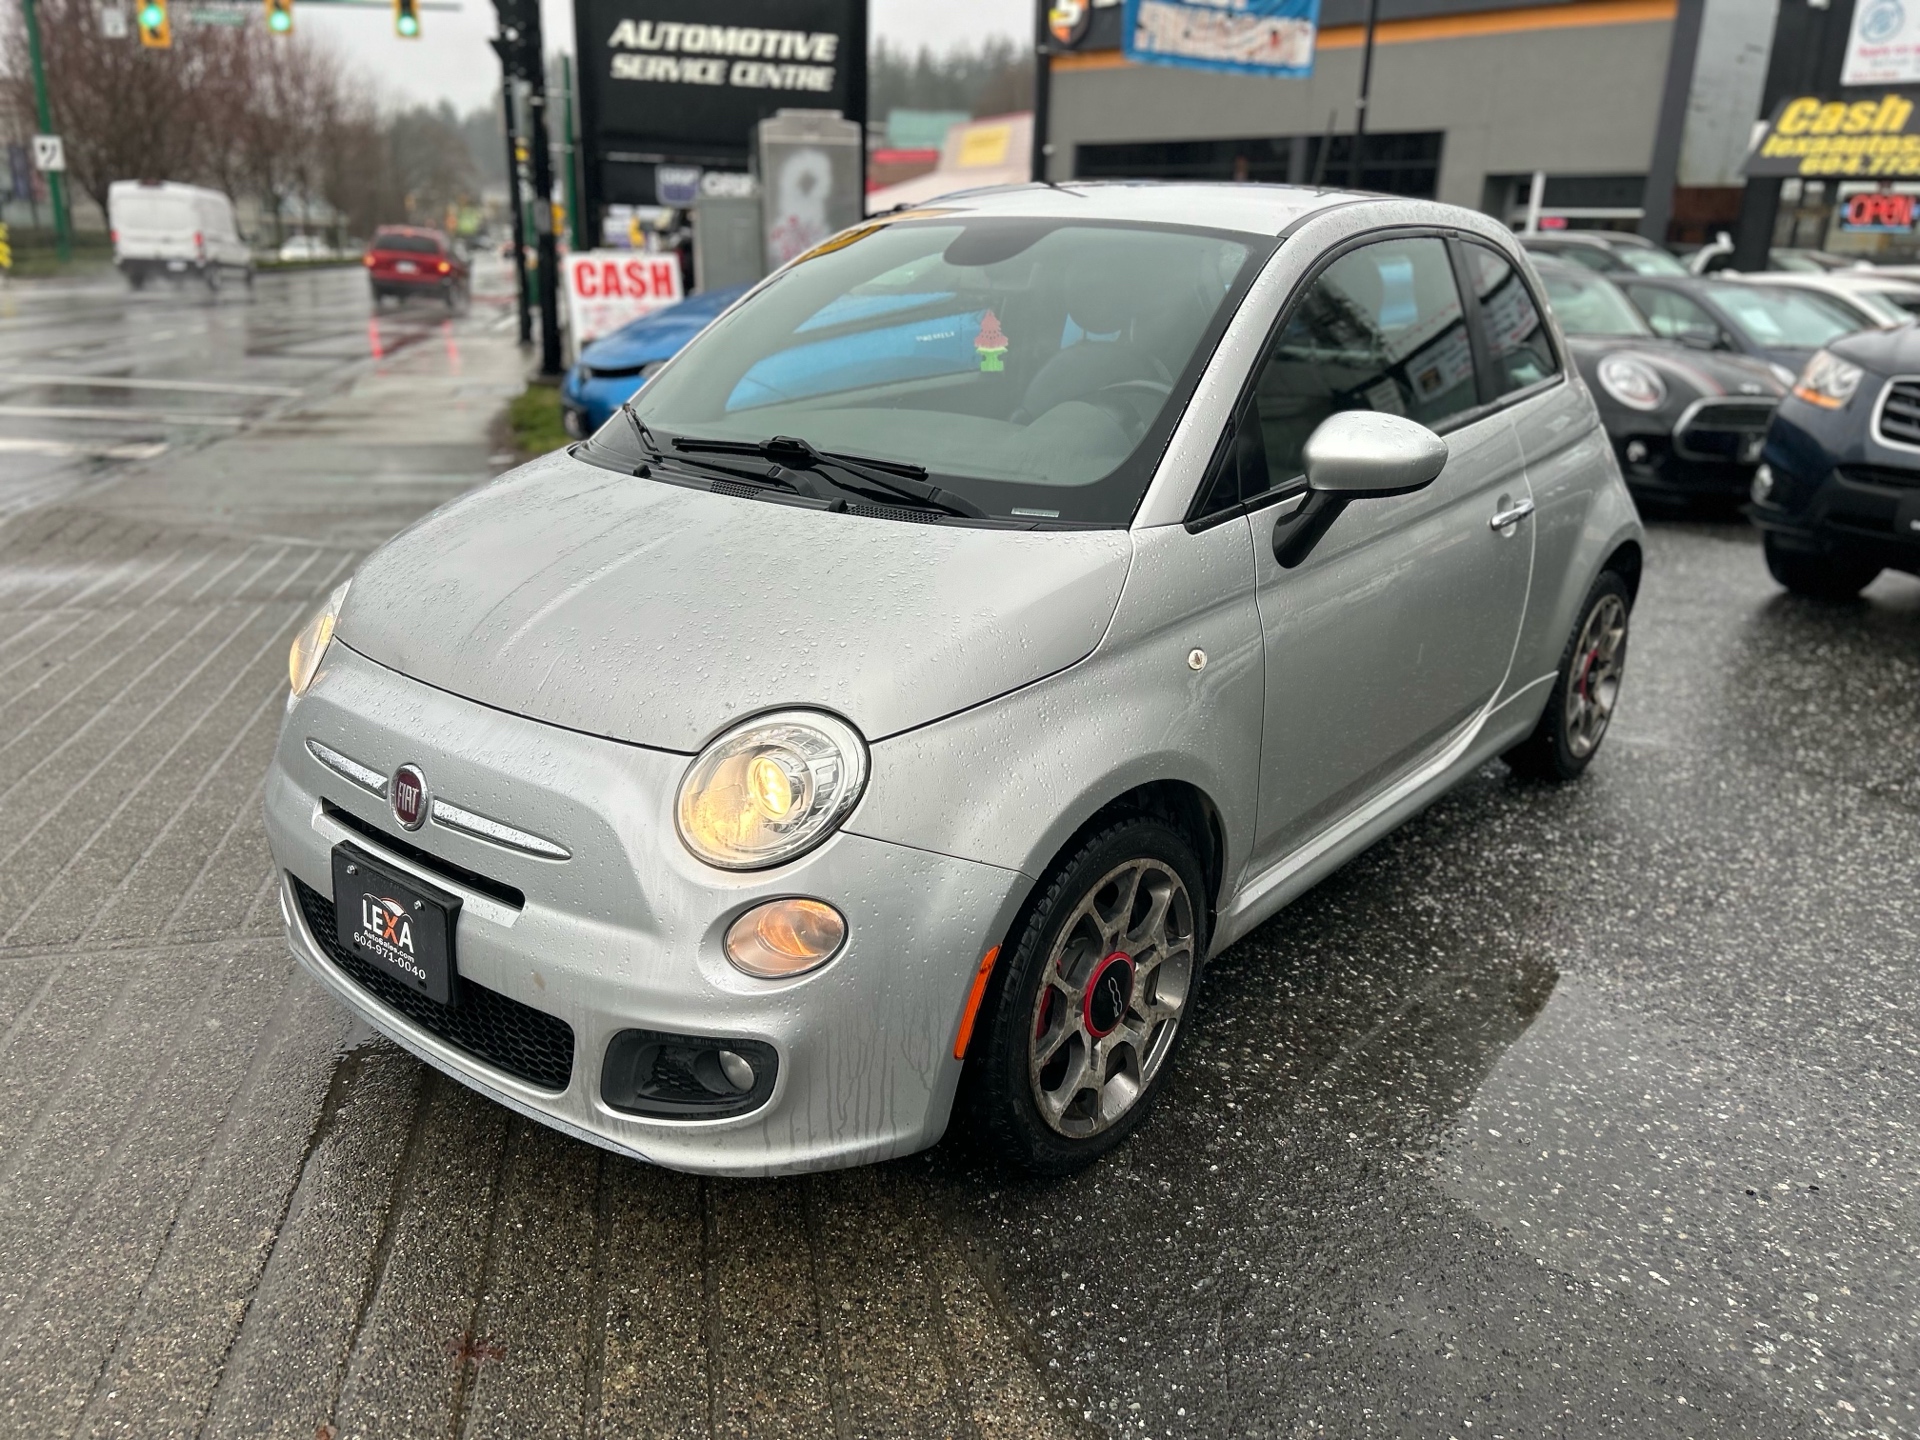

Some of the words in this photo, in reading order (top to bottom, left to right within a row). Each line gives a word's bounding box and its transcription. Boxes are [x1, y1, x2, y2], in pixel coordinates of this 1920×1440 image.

[608, 18, 839, 62] AUTOMOTIVE
[610, 53, 728, 85] SERVICE
[730, 61, 836, 92] CENTRE
[1777, 94, 1914, 134] Cash
[397, 781, 419, 815] FIAT
[362, 899, 414, 954] LEXA
[353, 931, 426, 980] 604-971-0040
